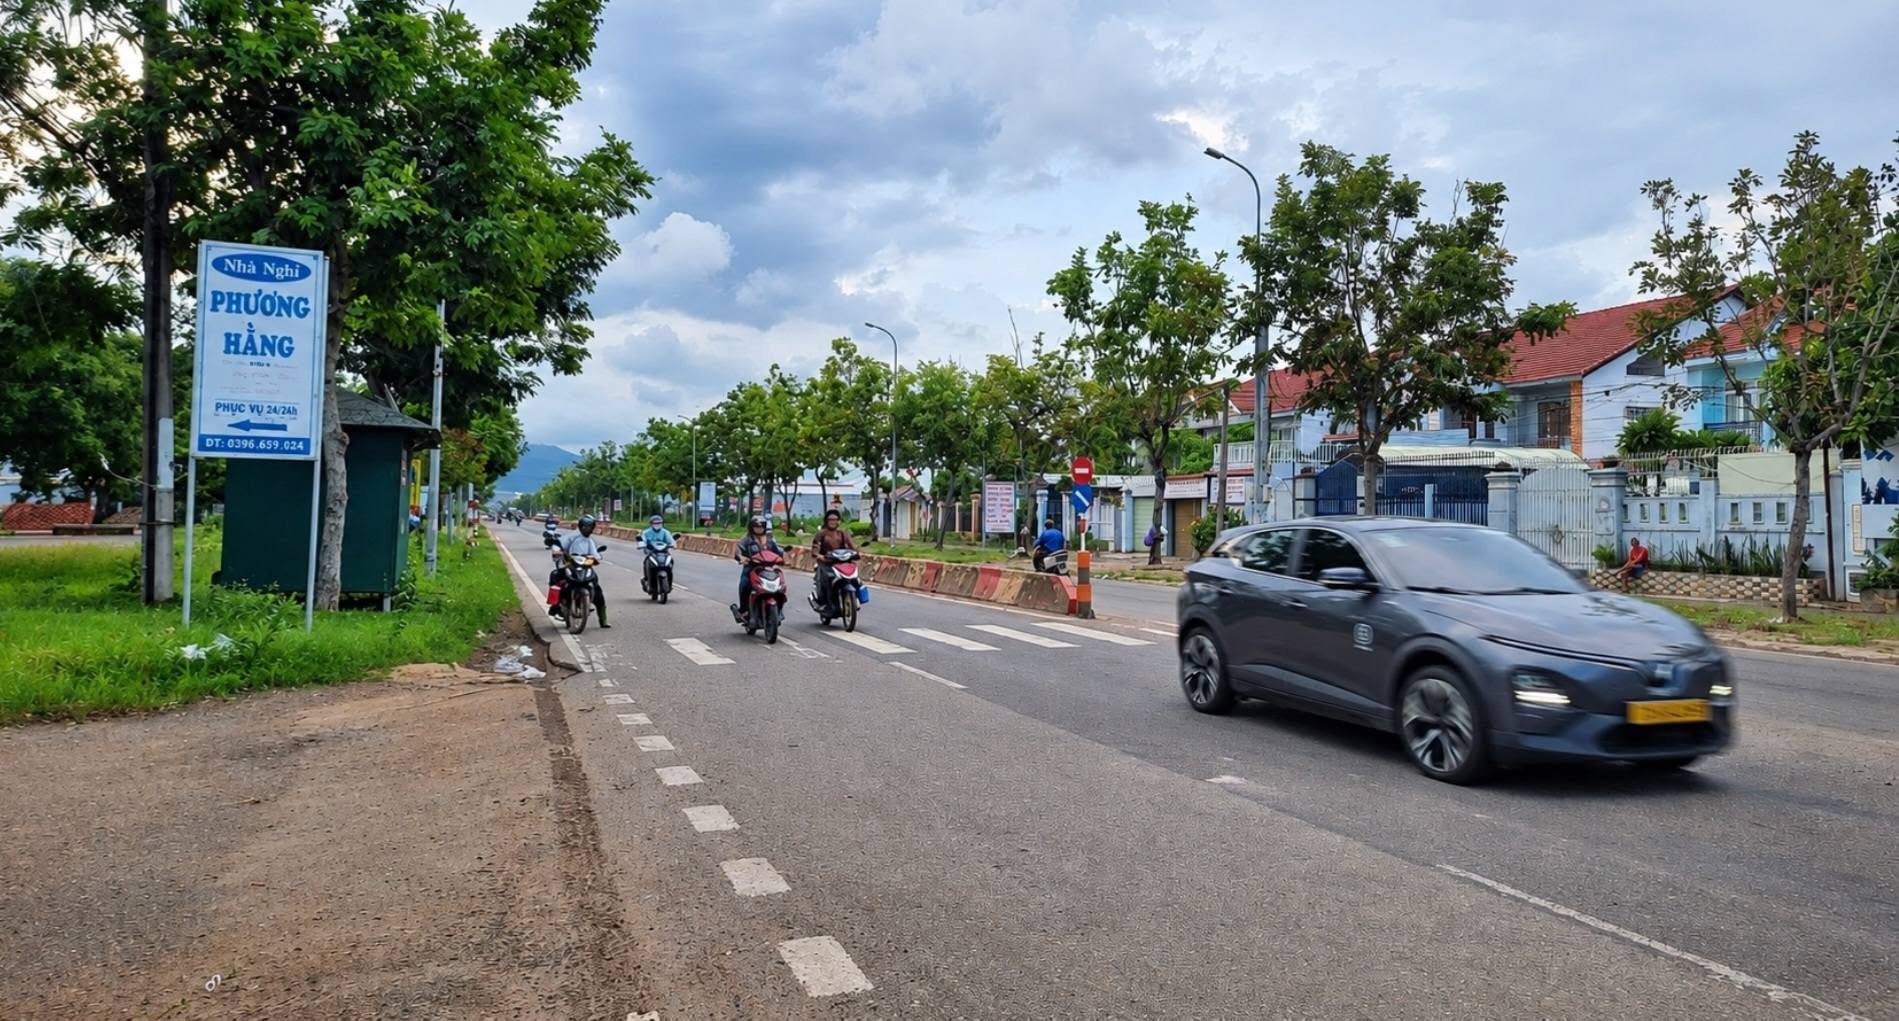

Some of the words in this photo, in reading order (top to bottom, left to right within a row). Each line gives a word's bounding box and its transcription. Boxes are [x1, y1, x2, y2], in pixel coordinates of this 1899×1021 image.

[224, 258, 256, 274] Nhà
[210, 289, 311, 319] PHƯƠNG
[223, 322, 295, 358] HẰNG
[215, 402, 246, 416] PHỤC
[249, 403, 264, 416] VỤ
[227, 438, 304, 450] 0396.659.024
